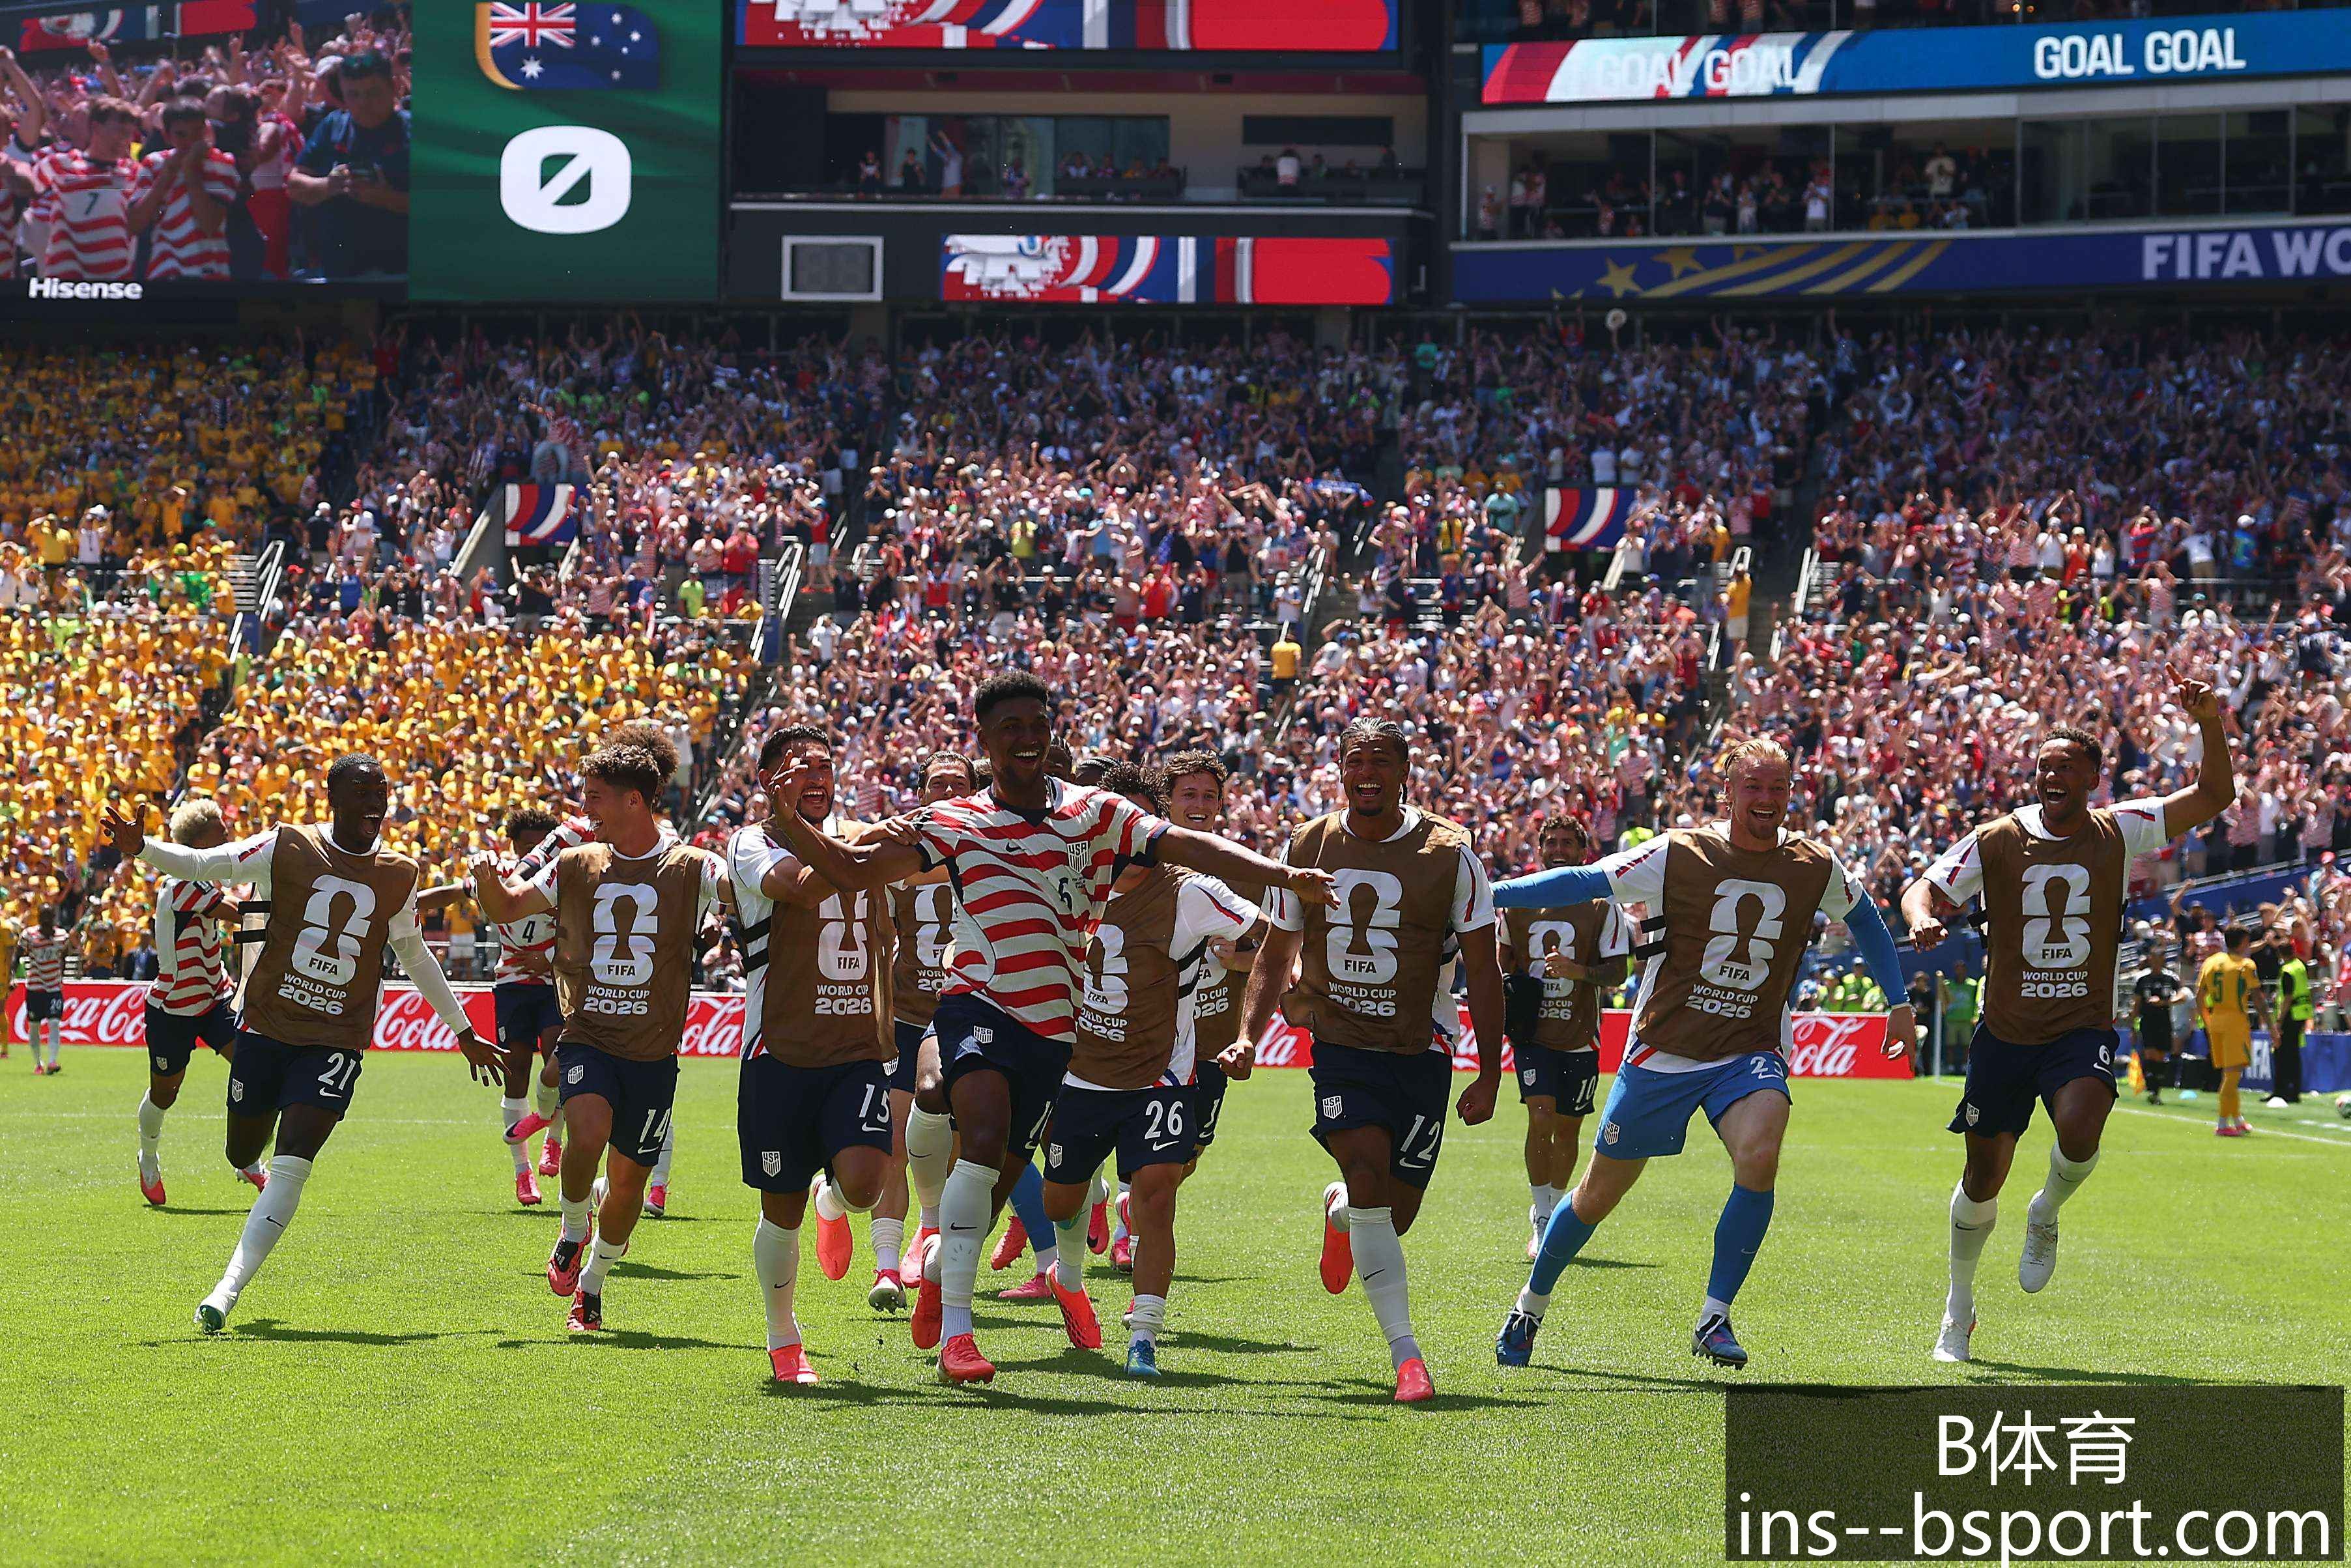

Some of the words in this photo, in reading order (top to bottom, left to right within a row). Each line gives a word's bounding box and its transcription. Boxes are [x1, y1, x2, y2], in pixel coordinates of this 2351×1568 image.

[2034, 33, 2135, 79] GOAL
[2144, 27, 2246, 73] GOAL
[1599, 50, 1694, 91] GOAL
[1705, 45, 1800, 89] GOAL
[500, 125, 631, 235] 0
[85, 192, 100, 216] 7
[2143, 232, 2264, 279] FIFA
[29, 278, 143, 299] Hisense
[1068, 842, 1087, 856] USA
[522, 920, 535, 943] 4
[838, 957, 860, 969] FIFA
[2042, 948, 2073, 959] FIFA
[309, 958, 337, 975] FIFA
[607, 964, 636, 976] FIFA
[1345, 959, 1376, 973] FIFA
[1719, 965, 1750, 981] FIFA
[918, 978, 945, 991] 20
[2022, 971, 2064, 981] WORLD
[2066, 971, 2088, 981] CUP
[284, 972, 324, 993] WORLD
[326, 988, 347, 1000] CUP
[588, 984, 627, 999] WORLD
[629, 990, 650, 999] CUP
[817, 984, 853, 996] WORLD
[855, 984, 869, 995] CUP
[1209, 986, 1228, 1000] CUP
[1329, 981, 1368, 997] WORLD
[1371, 989, 1397, 999] CUP
[1693, 984, 1734, 1001] WORLD
[1736, 993, 1758, 1004] CUP
[2021, 982, 2088, 998] 2026
[278, 984, 344, 1016] 2026
[584, 997, 648, 1015] 2026
[815, 997, 872, 1016] 2026
[1088, 991, 1108, 1005] FIFA
[1685, 995, 1752, 1019] 2026
[1080, 1007, 1102, 1023] ORLD
[1104, 1016, 1128, 1028] CUP
[1537, 1007, 1572, 1021] 026
[1078, 1016, 1126, 1042] 026
[2099, 1045, 2111, 1066] 6
[317, 1052, 356, 1090] 21
[1576, 1075, 1596, 1104] 10
[859, 1083, 889, 1123] 15
[1324, 1096, 1341, 1106] USA
[640, 1107, 671, 1143] 14
[1145, 1101, 1183, 1139] 26
[1401, 1115, 1440, 1162] 12
[763, 1152, 780, 1162] USA
